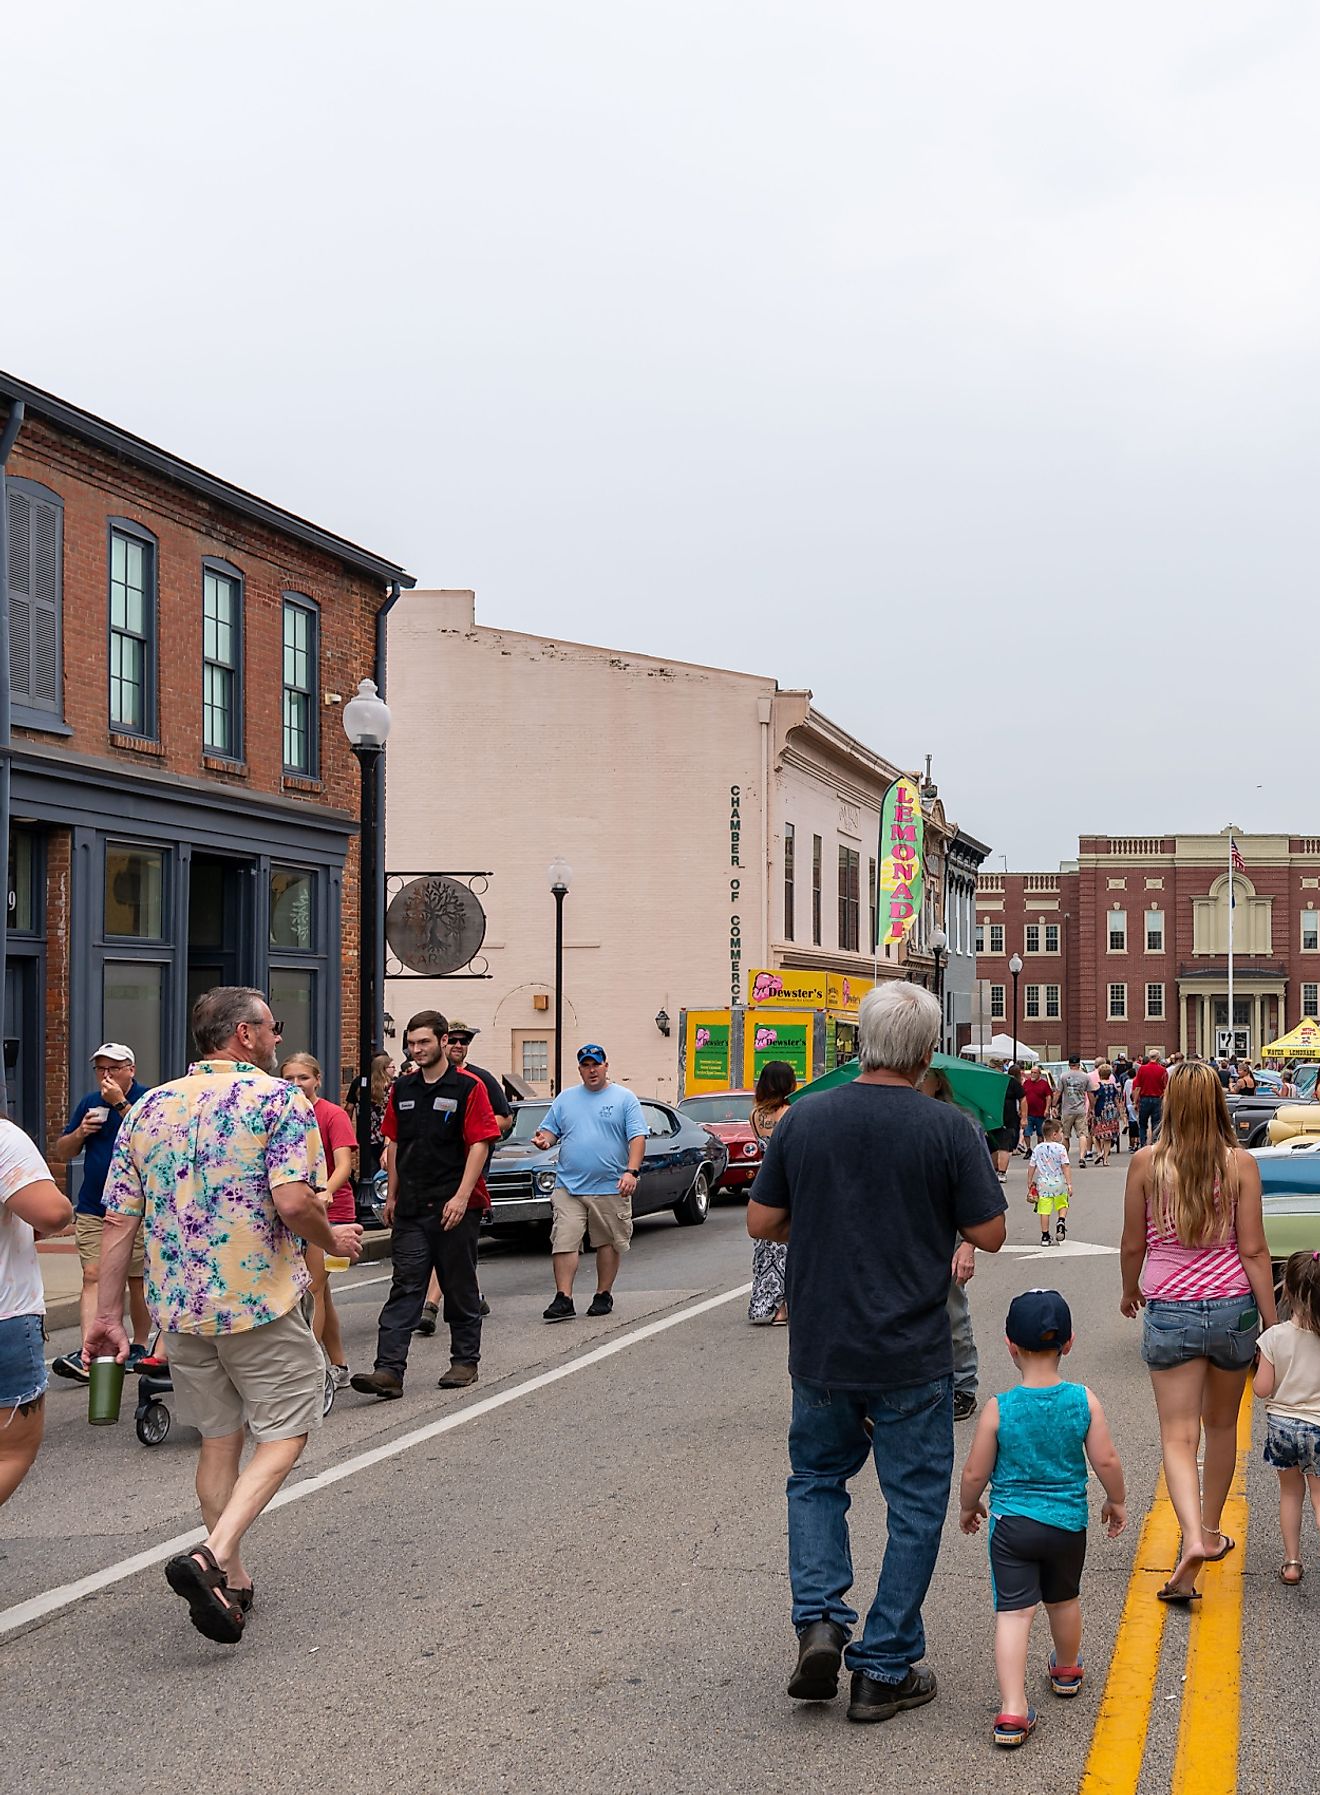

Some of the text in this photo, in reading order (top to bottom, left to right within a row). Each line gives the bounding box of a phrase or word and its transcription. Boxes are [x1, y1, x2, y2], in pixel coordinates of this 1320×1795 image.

[730, 785, 741, 1006] CHAMBER OF COMMERCE
[888, 786, 917, 938] LEMONADE
[768, 987, 823, 999] Dewster's
[766, 1038, 806, 1046] Dewster's
